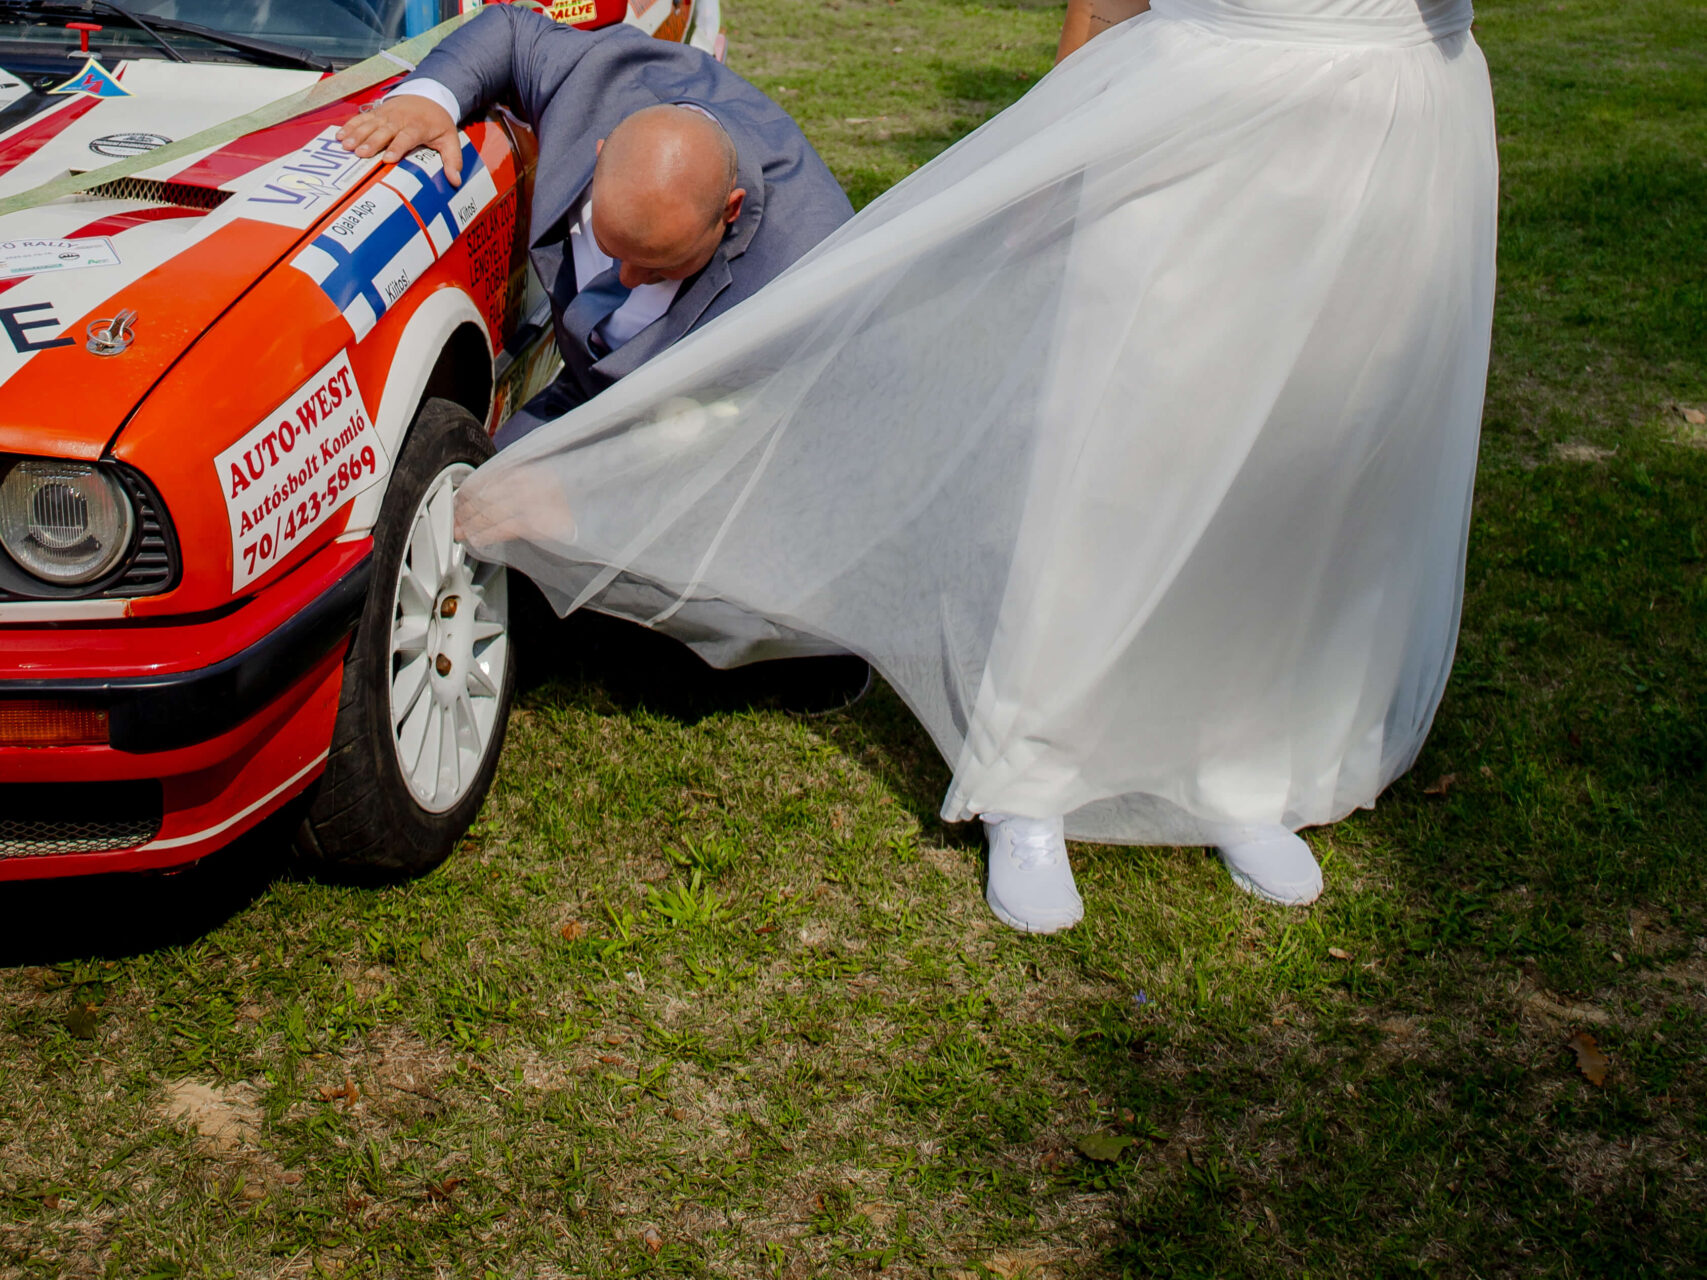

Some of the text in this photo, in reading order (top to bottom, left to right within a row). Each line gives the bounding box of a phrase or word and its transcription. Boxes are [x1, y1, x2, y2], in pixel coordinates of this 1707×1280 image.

[331, 200, 376, 235] Ojala Alpo
[457, 197, 478, 225] Kiitos!
[23, 241, 80, 249] RALLY
[385, 268, 411, 303] Kiitos!
[230, 364, 353, 500] AUTO-WEST
[239, 409, 365, 538] Autósbolt Komló
[243, 445, 376, 576] 70/423-5869
